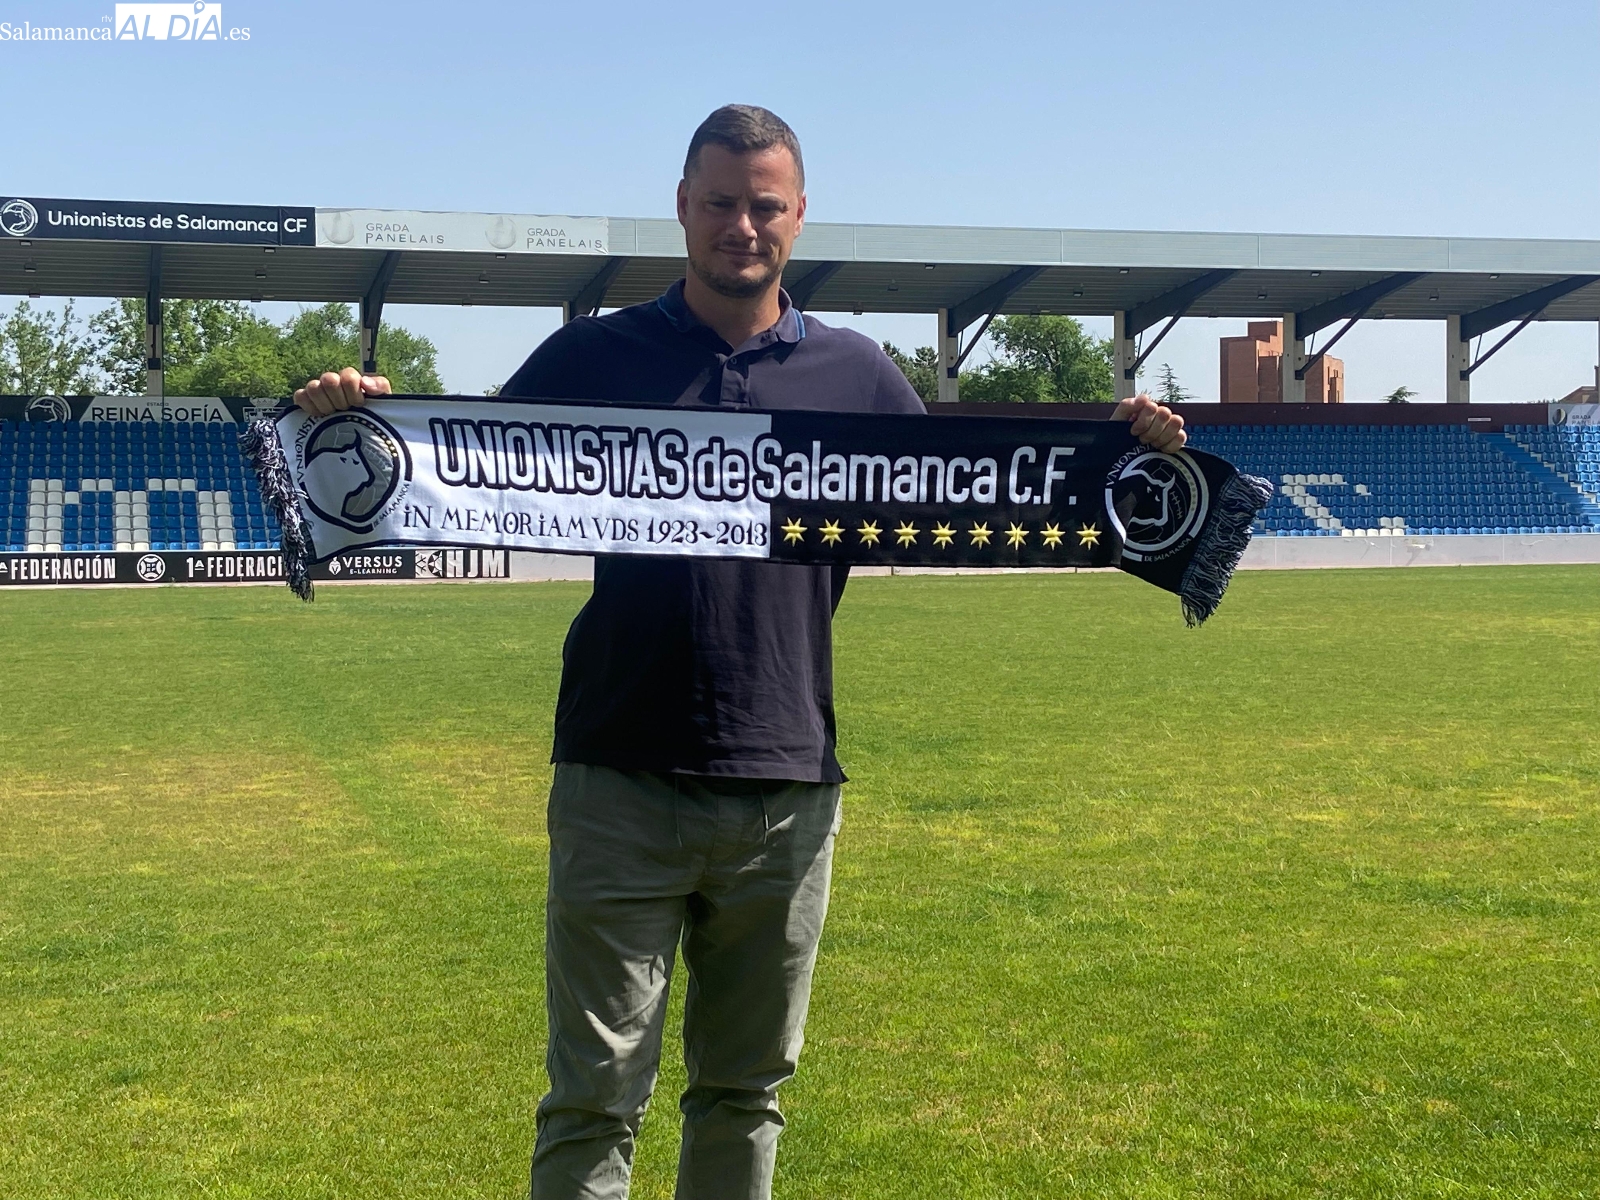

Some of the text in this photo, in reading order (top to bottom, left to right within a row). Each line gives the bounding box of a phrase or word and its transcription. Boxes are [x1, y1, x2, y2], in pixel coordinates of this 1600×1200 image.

[48, 210, 145, 229] Unionistas
[149, 213, 173, 230] de
[177, 214, 278, 233] Salamanca
[284, 217, 307, 233] CF
[365, 222, 410, 232] GRADA
[365, 233, 445, 244] PANELAIS
[527, 227, 566, 237] GRADA
[527, 237, 603, 248] PANELAIS
[92, 403, 223, 421] REINA SOFÍA
[430, 419, 1077, 505] UNIONISTAS de Salamanca C.F.
[592, 516, 639, 542] VDS
[11, 555, 116, 580] FEDERACIÓN
[207, 556, 283, 578] FEDERACI
[343, 556, 403, 569] VERSUS
[446, 549, 504, 578] HJM
